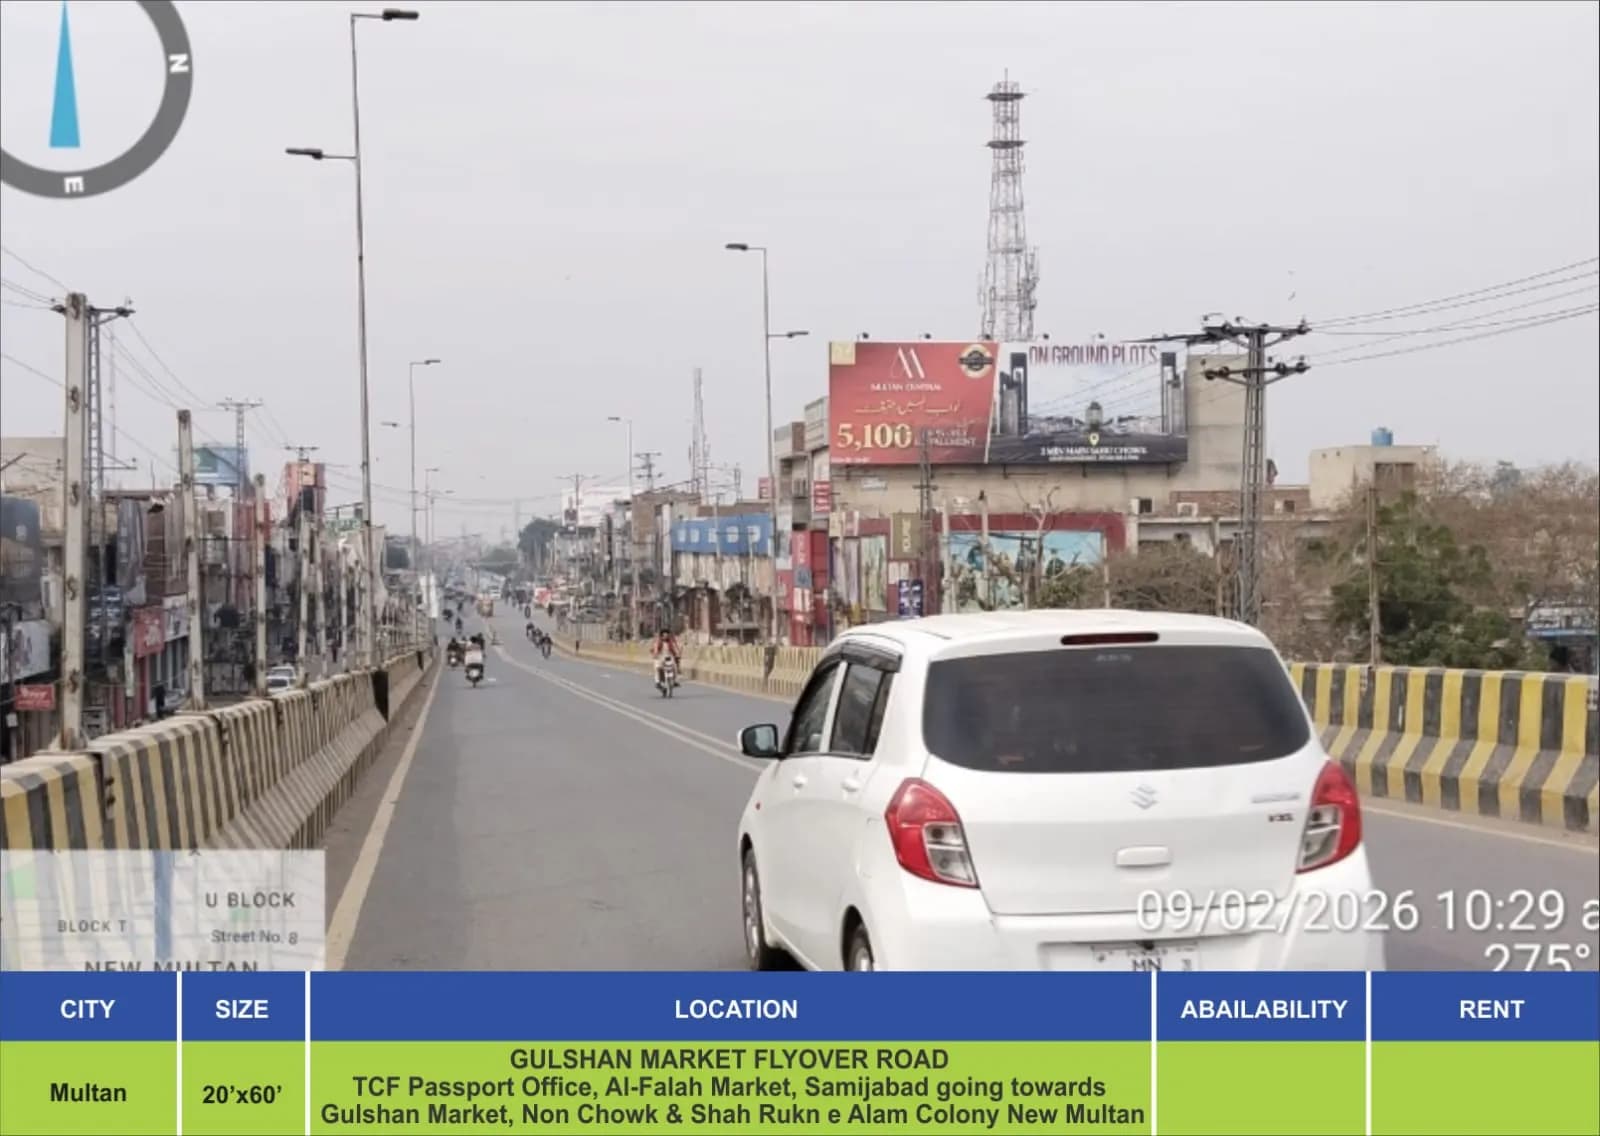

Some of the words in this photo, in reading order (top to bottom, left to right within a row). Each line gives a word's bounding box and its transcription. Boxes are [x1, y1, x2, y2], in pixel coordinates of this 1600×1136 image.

[1030, 346, 1049, 365] ON
[1052, 345, 1109, 366] GROUND
[1112, 345, 1158, 366] PLOTS
[837, 423, 912, 451] 5,100
